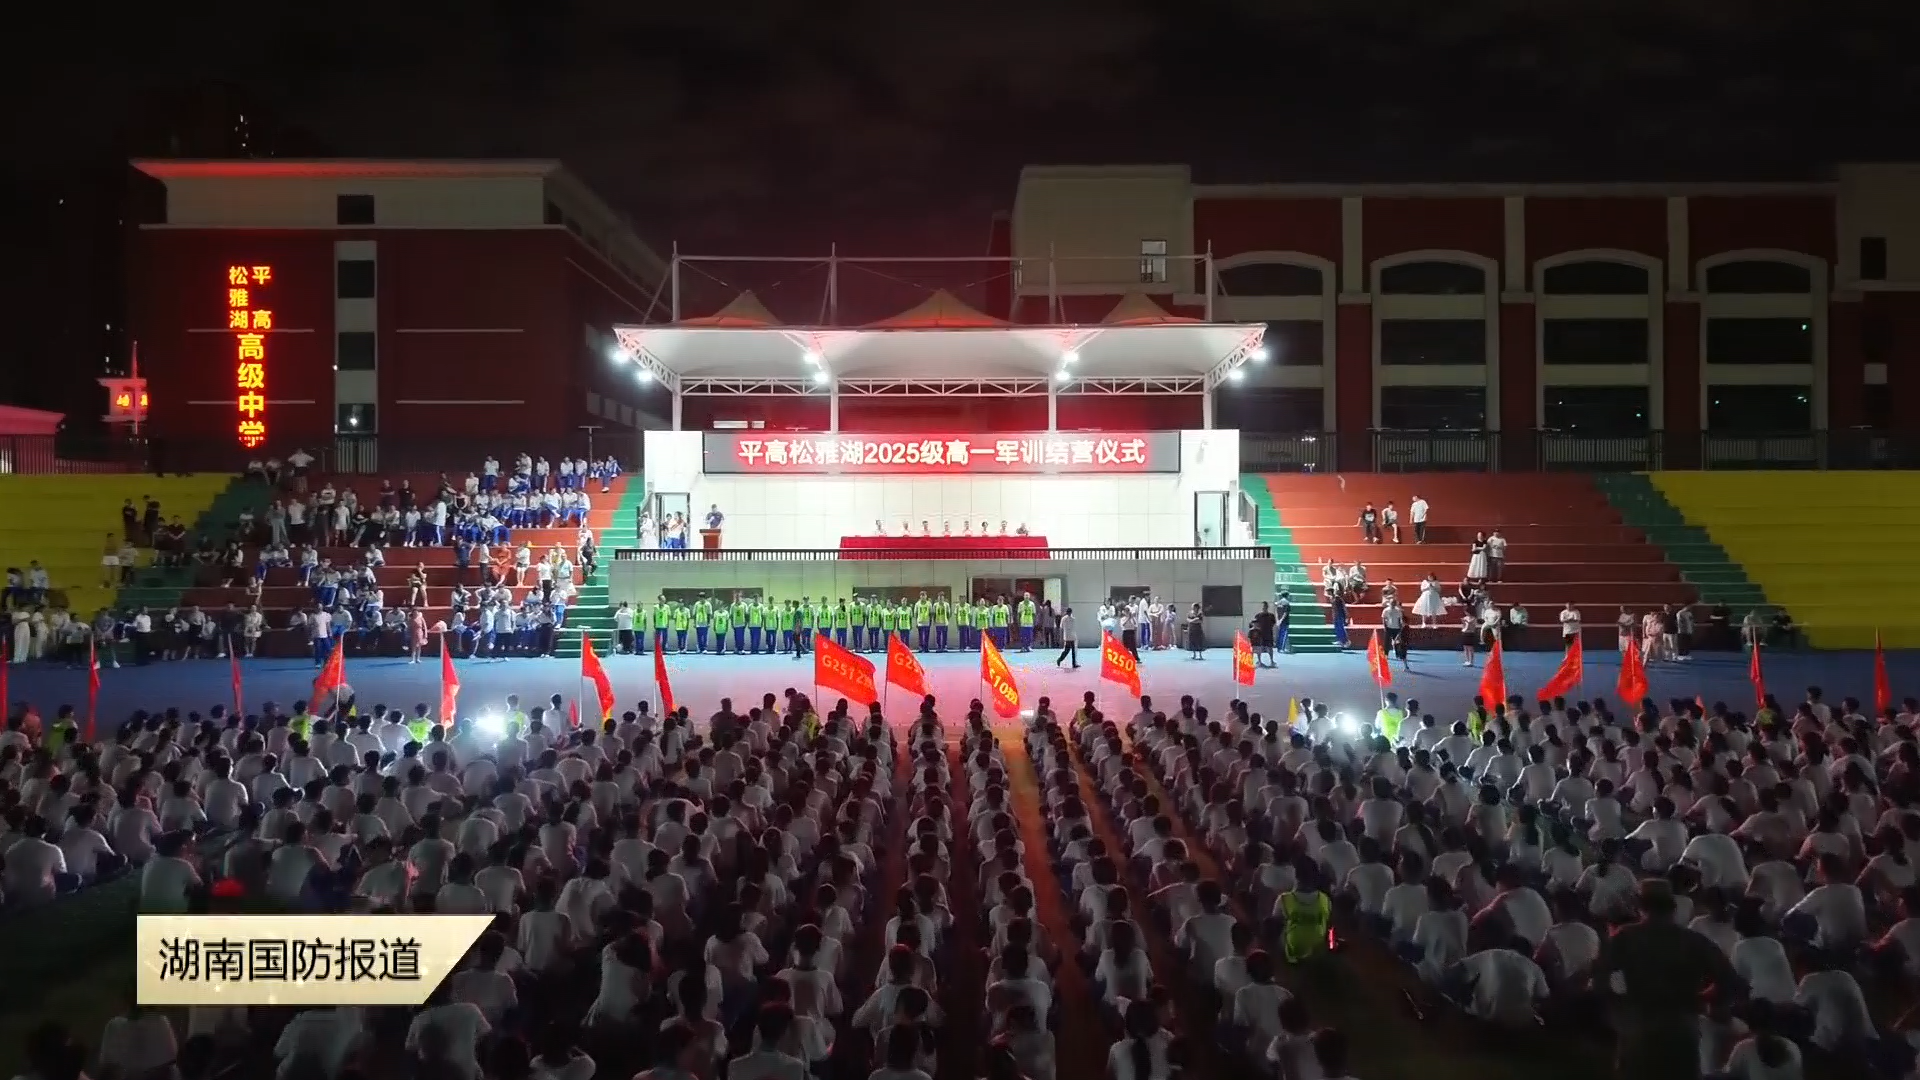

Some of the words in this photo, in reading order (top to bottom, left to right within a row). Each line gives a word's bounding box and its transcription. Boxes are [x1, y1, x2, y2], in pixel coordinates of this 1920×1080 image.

[229, 265, 249, 329] 松雅湖
[237, 333, 266, 447] 高级中学
[738, 440, 1146, 466] 平高松雅湖2025级高一军训结营仪式
[1106, 648, 1139, 677] G250
